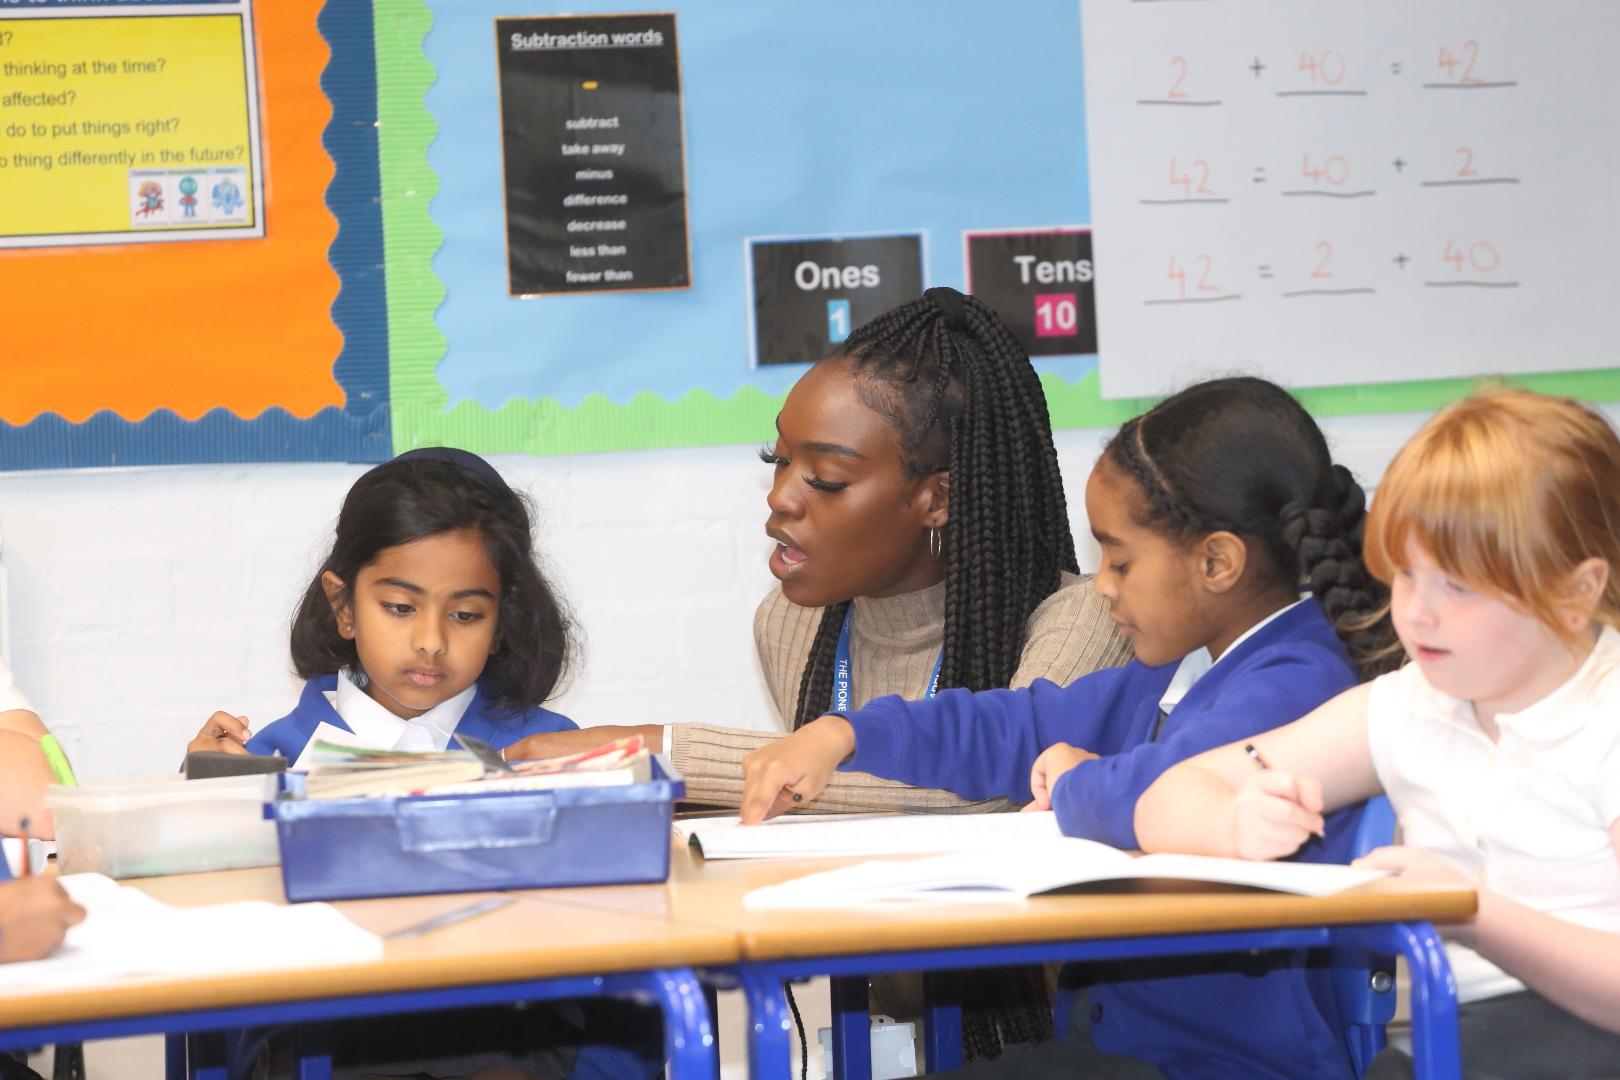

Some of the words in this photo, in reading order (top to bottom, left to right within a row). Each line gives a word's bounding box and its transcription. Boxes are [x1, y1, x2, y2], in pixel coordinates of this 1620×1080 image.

[511, 30, 608, 49] Subtraction
[611, 28, 663, 46] words
[4, 61, 67, 79] thinking
[72, 61, 88, 76] at
[93, 60, 117, 75] the
[123, 58, 166, 74] time?
[1167, 56, 1189, 98] 2
[1297, 50, 1346, 85] 40
[1437, 40, 1486, 85] 42
[2, 90, 76, 108] affected?
[6, 123, 27, 138] do
[32, 122, 47, 137] to
[52, 121, 78, 139] put
[82, 119, 131, 138] things
[136, 117, 180, 136] right?
[565, 116, 619, 130] subtract
[13, 152, 53, 170] thing
[58, 150, 136, 168] differently
[141, 148, 156, 164] in
[160, 147, 185, 163] the
[189, 145, 244, 163] future?
[561, 143, 590, 156] take
[592, 142, 626, 156] away
[575, 169, 614, 181] minus
[1169, 157, 1216, 195] 42
[1302, 154, 1350, 186] 40
[1457, 147, 1478, 177] 2
[563, 194, 629, 208] difference
[566, 219, 628, 233] decrease
[569, 245, 596, 258] less
[597, 244, 627, 257] than
[566, 271, 602, 283] fewer
[604, 269, 634, 282] than
[794, 260, 881, 291] Ones
[1013, 255, 1094, 285] Tens
[1168, 255, 1220, 298] 42
[1310, 241, 1334, 279] 2
[1443, 240, 1500, 272] 40
[829, 307, 845, 336] 1
[1037, 301, 1077, 331] 10
[838, 659, 848, 679] THE
